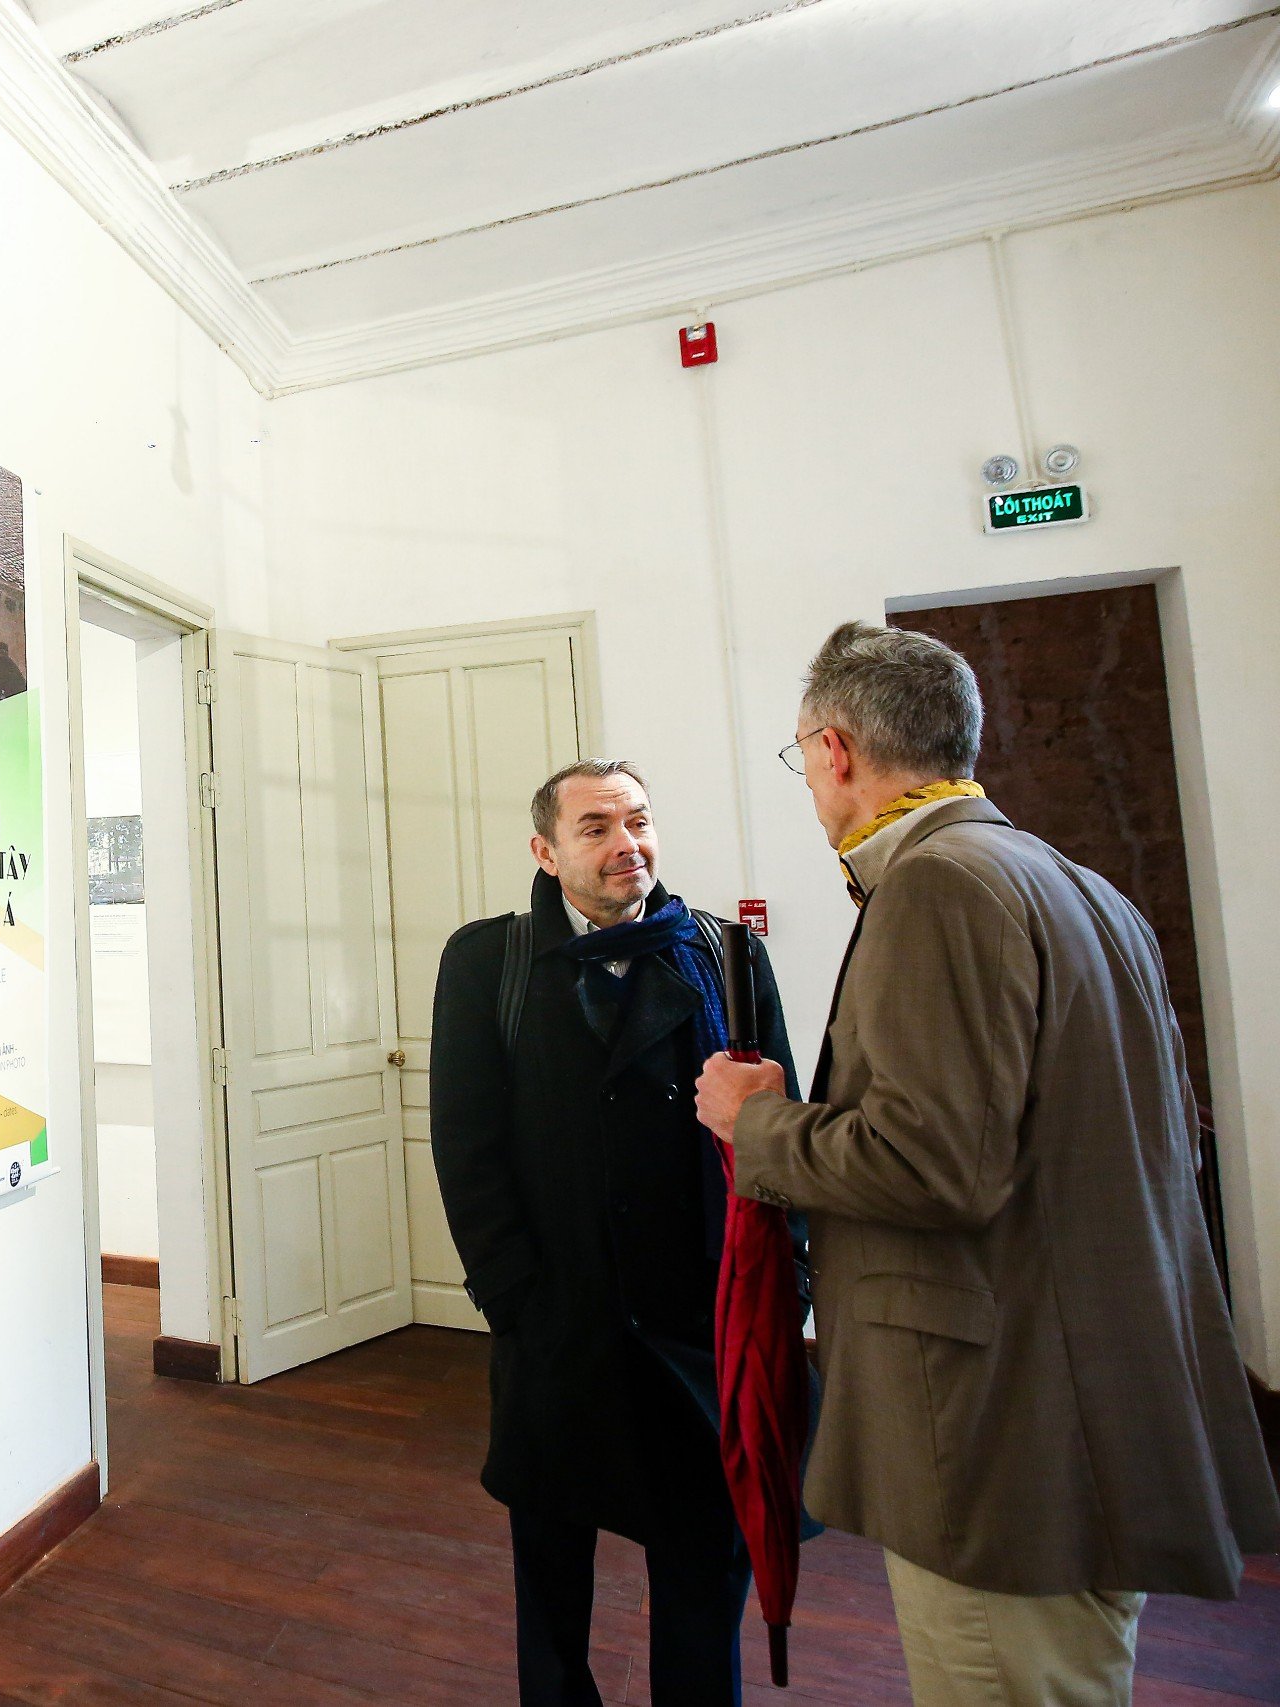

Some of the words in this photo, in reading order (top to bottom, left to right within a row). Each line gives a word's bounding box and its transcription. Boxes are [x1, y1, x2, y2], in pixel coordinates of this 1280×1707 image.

[1021, 490, 1073, 512] THOÁT
[1016, 511, 1054, 524] EXIT
[3, 891, 15, 927] Á
[6, 1056, 26, 1070] PHOTO
